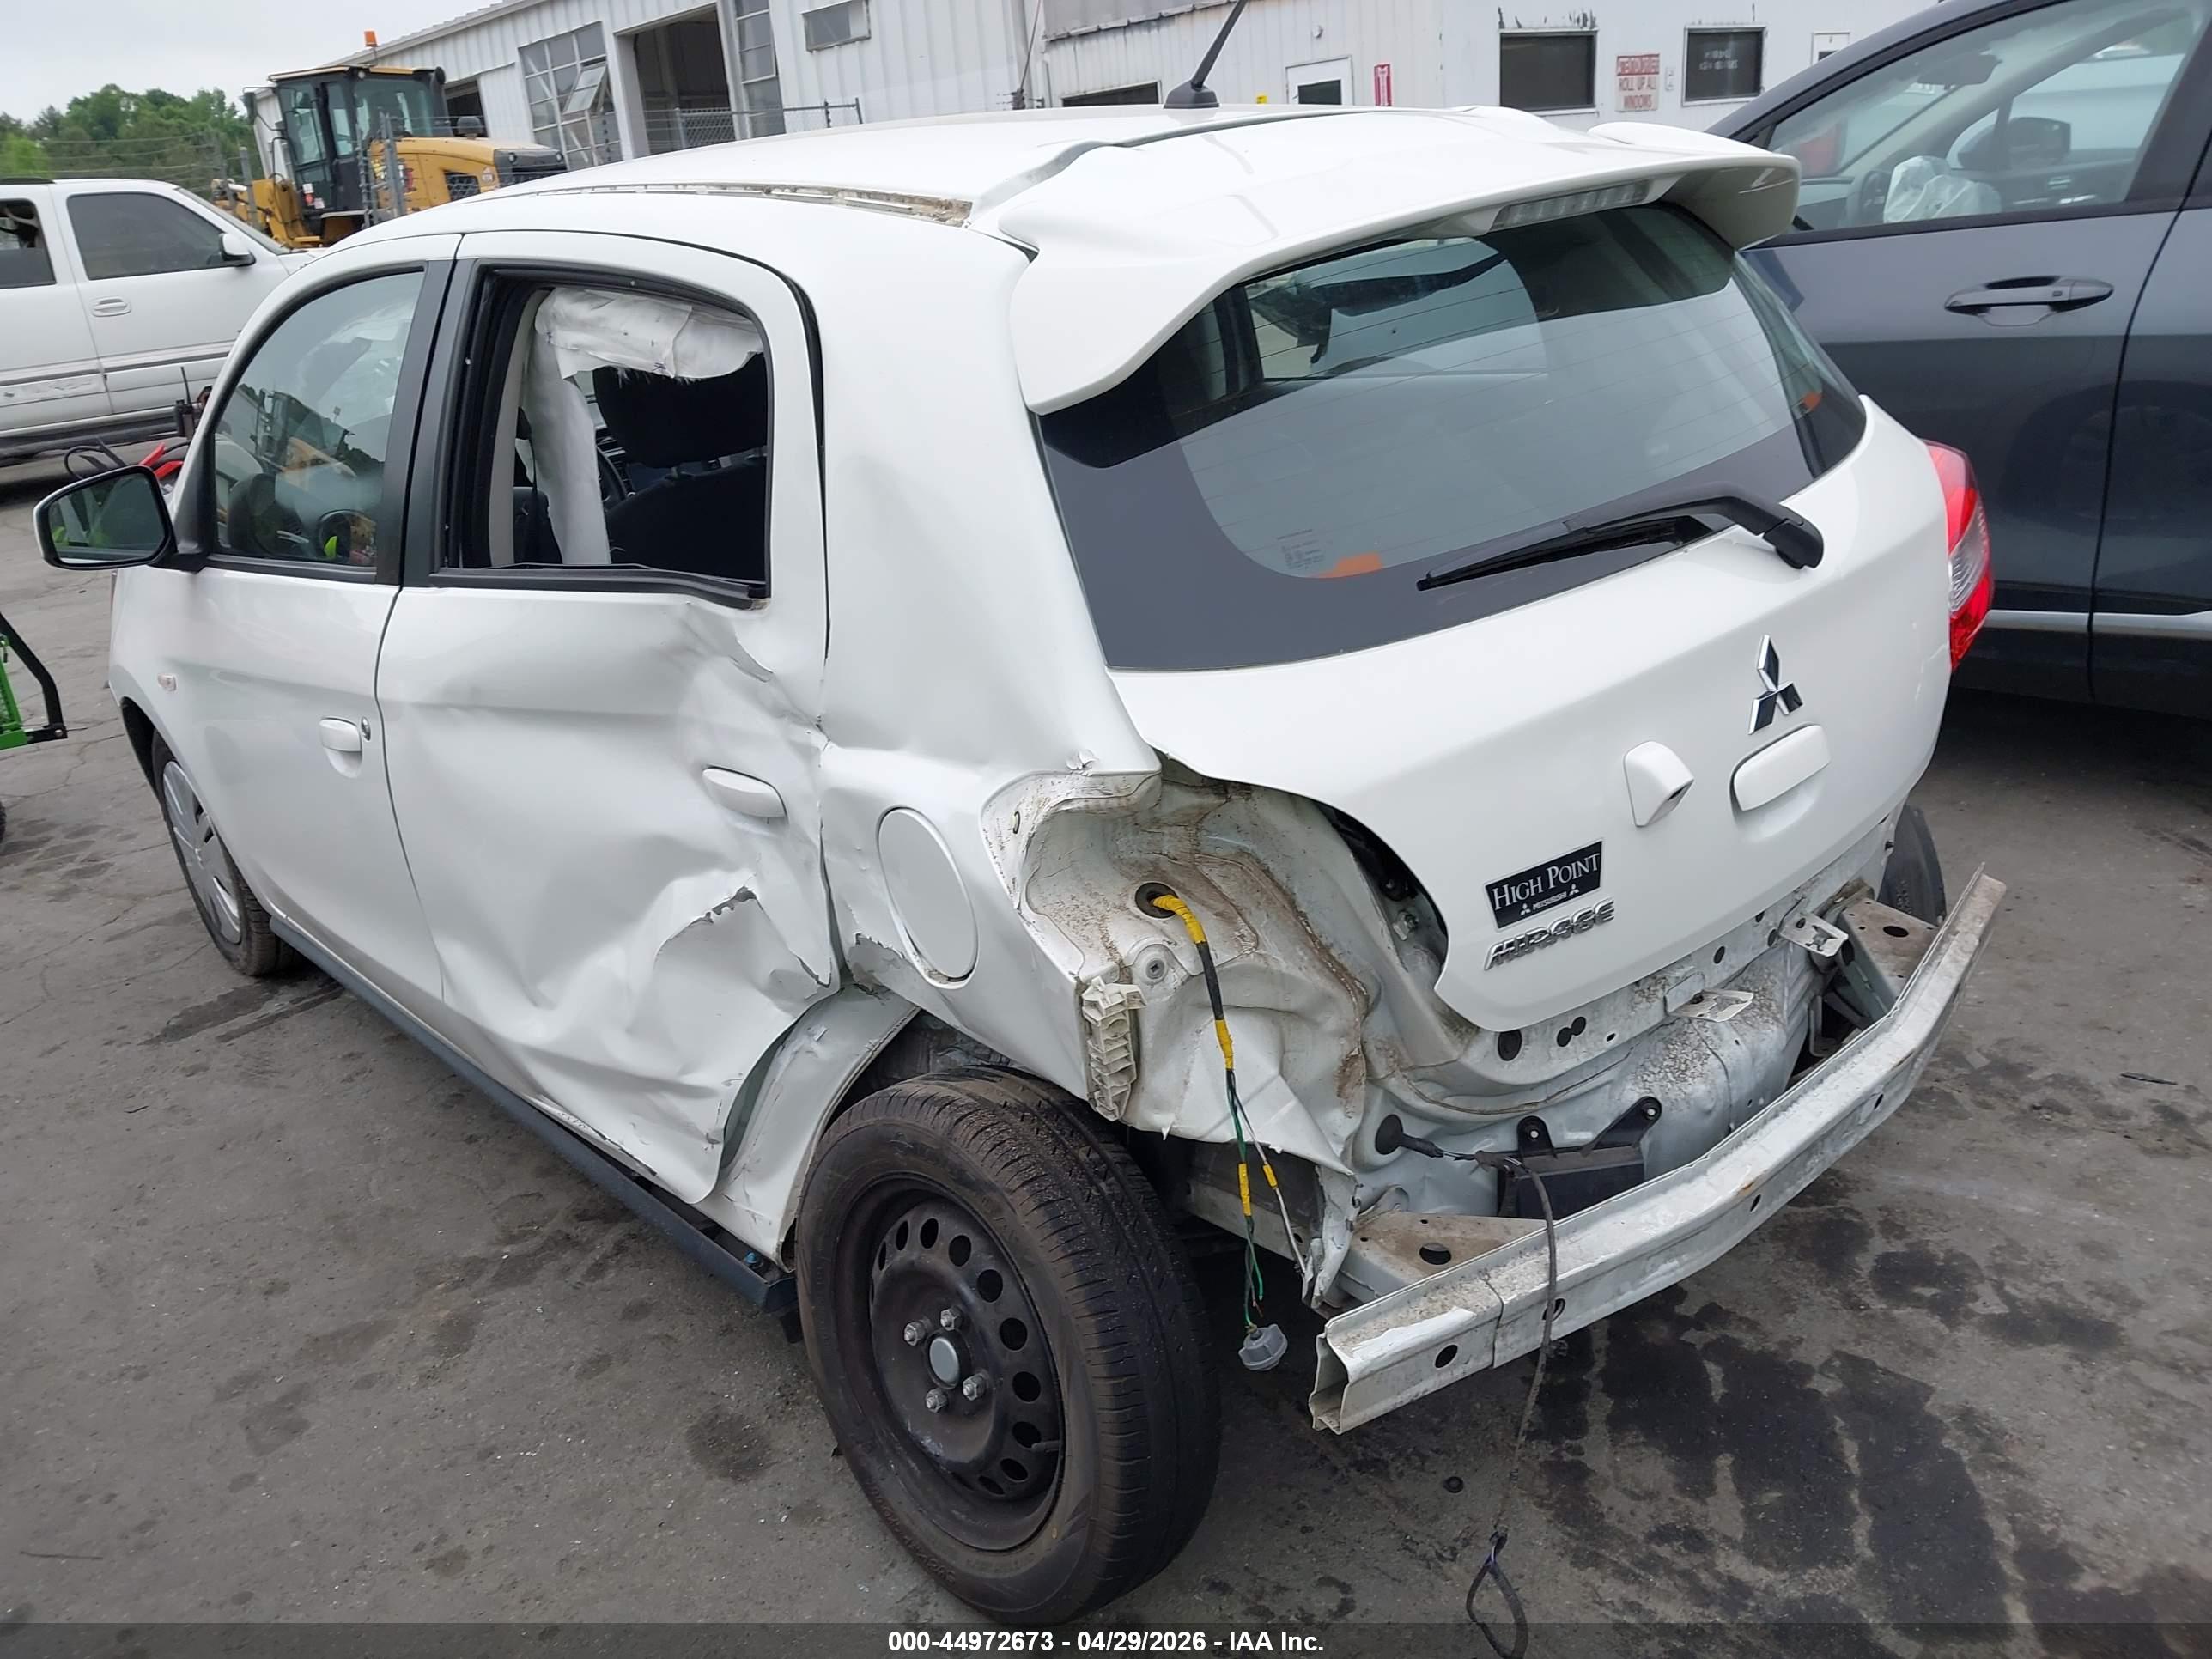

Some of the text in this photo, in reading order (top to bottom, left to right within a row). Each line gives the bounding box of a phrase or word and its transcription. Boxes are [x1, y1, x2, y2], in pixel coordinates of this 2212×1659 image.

[1492, 853, 1601, 911] HIGH POINT
[1484, 897, 1615, 971] MIRAGE
